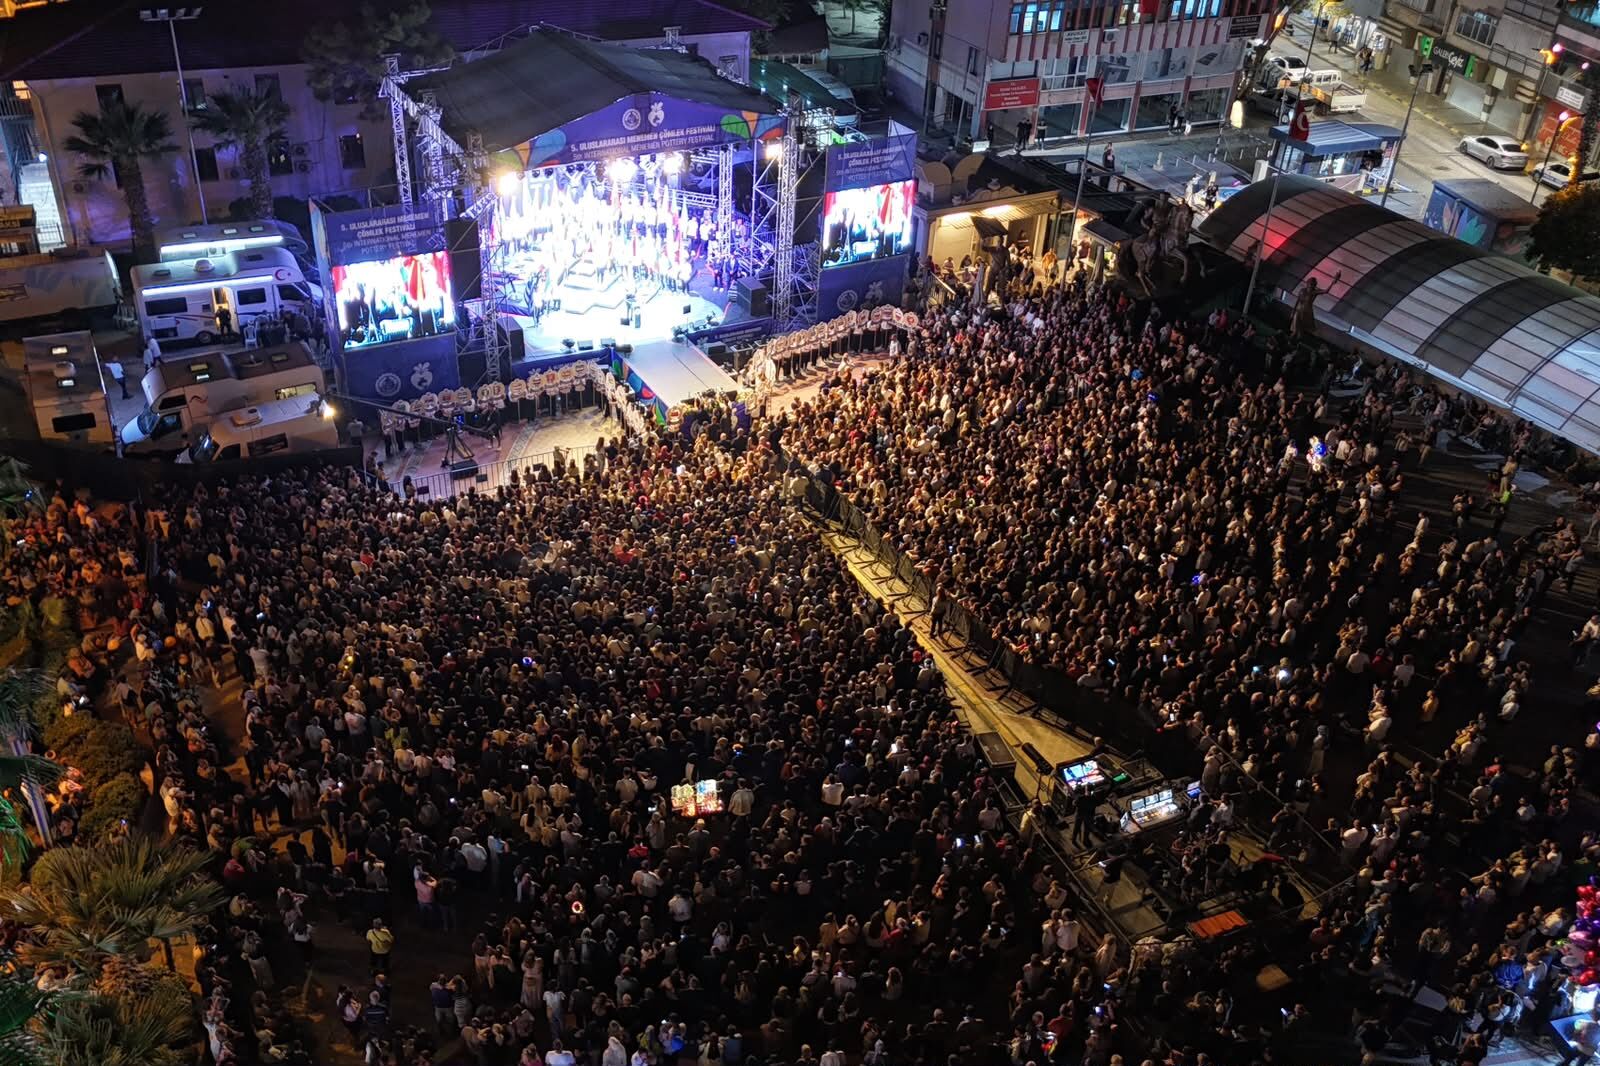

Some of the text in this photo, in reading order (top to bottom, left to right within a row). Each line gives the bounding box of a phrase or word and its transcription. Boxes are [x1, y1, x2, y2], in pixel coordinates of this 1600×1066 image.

[580, 136, 626, 151] ULUSLARARASI
[626, 132, 658, 144] MENEMEN
[659, 128, 685, 140] ÇÖMLEK
[661, 136, 688, 148] POTTERY
[349, 218, 396, 231] ULUSLARARASI
[356, 227, 384, 239] ÇÖMLEK
